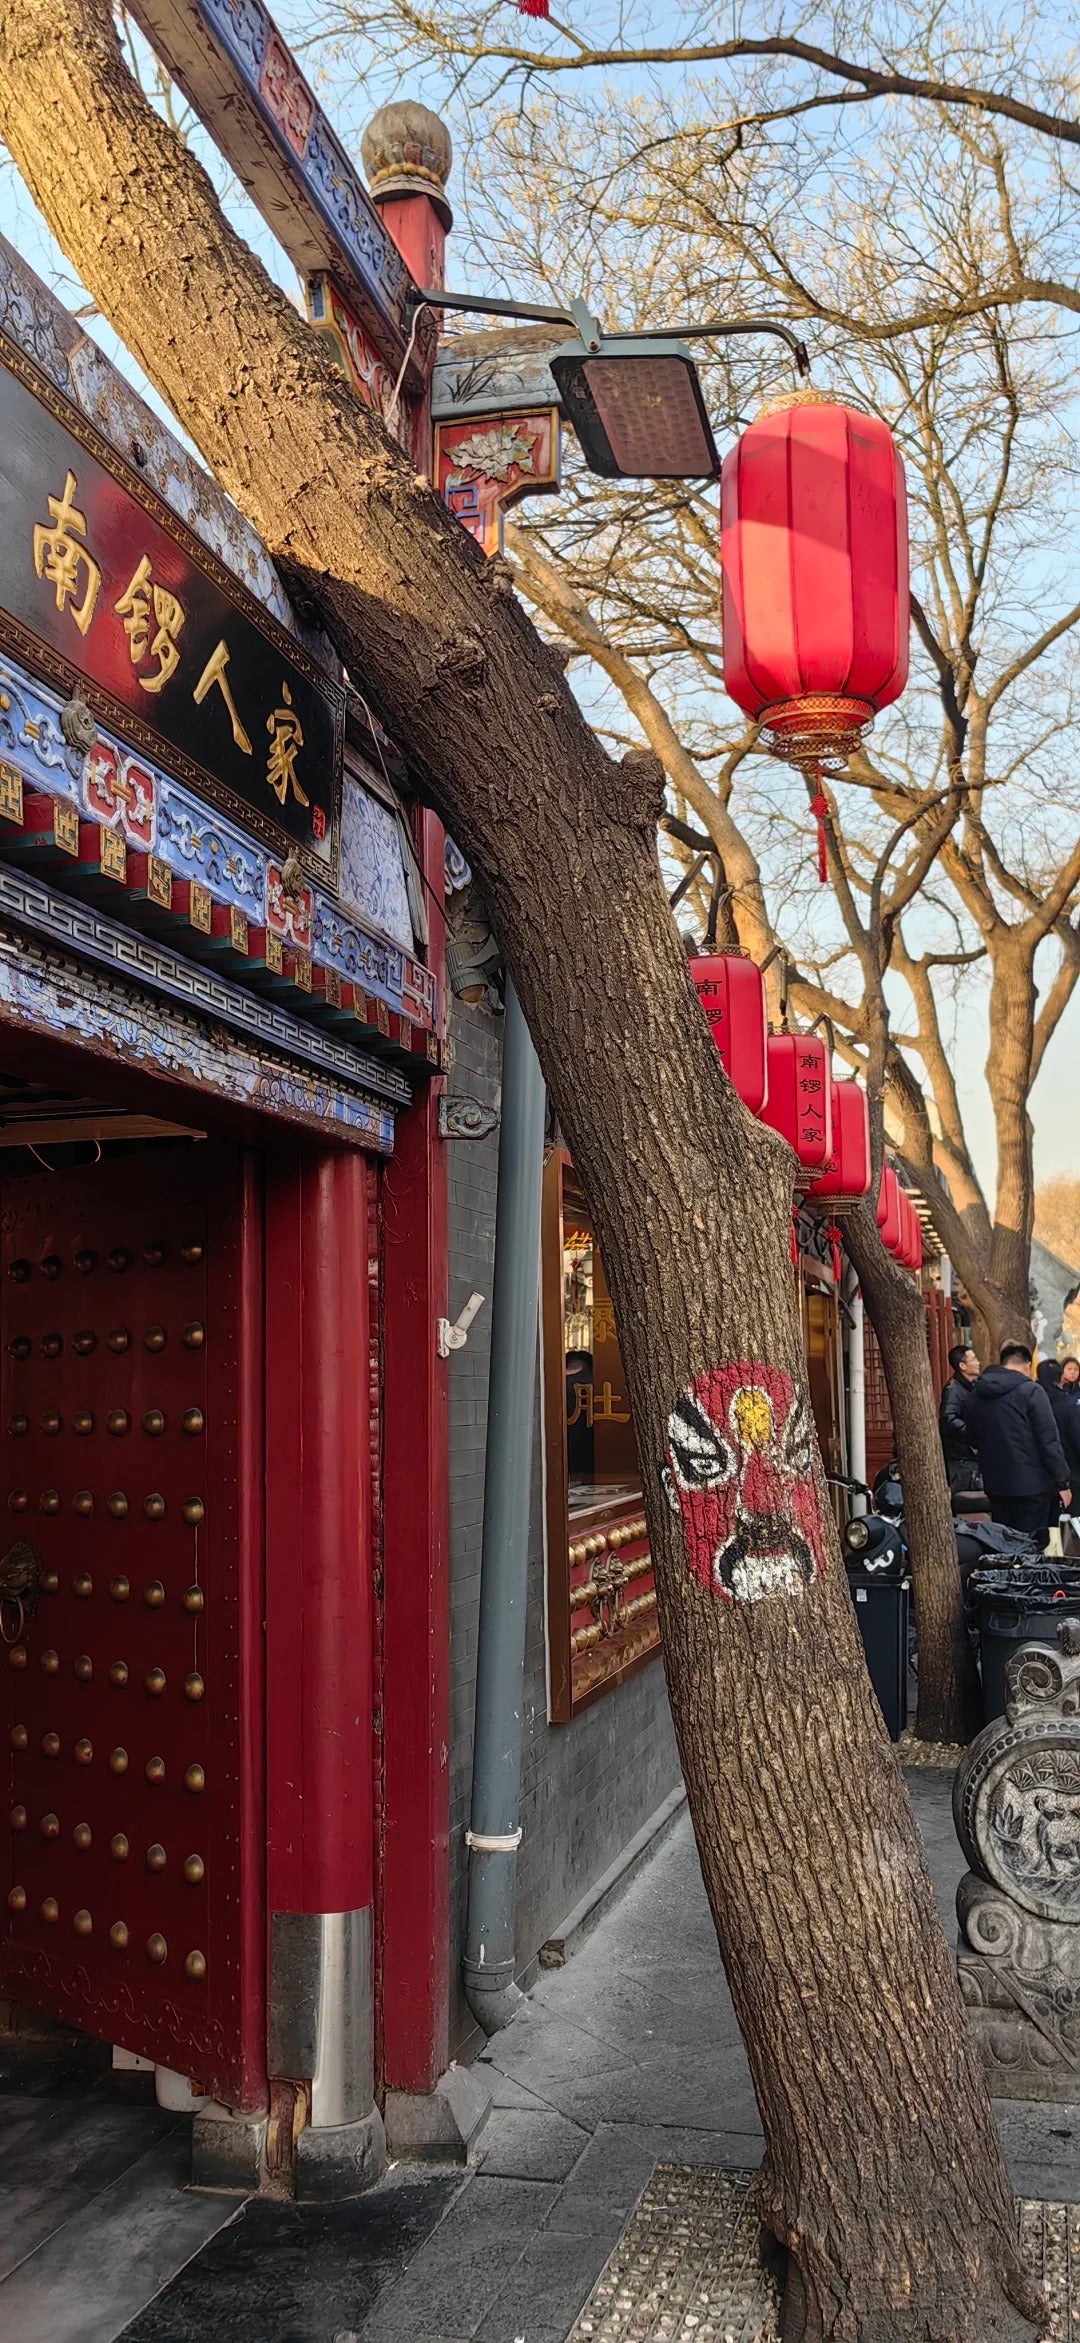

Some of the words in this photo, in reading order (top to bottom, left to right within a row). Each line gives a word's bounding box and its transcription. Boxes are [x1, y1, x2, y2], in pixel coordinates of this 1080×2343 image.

[33, 469, 310, 807] 南锣人家
[800, 1054, 823, 1143] 南锣人家
